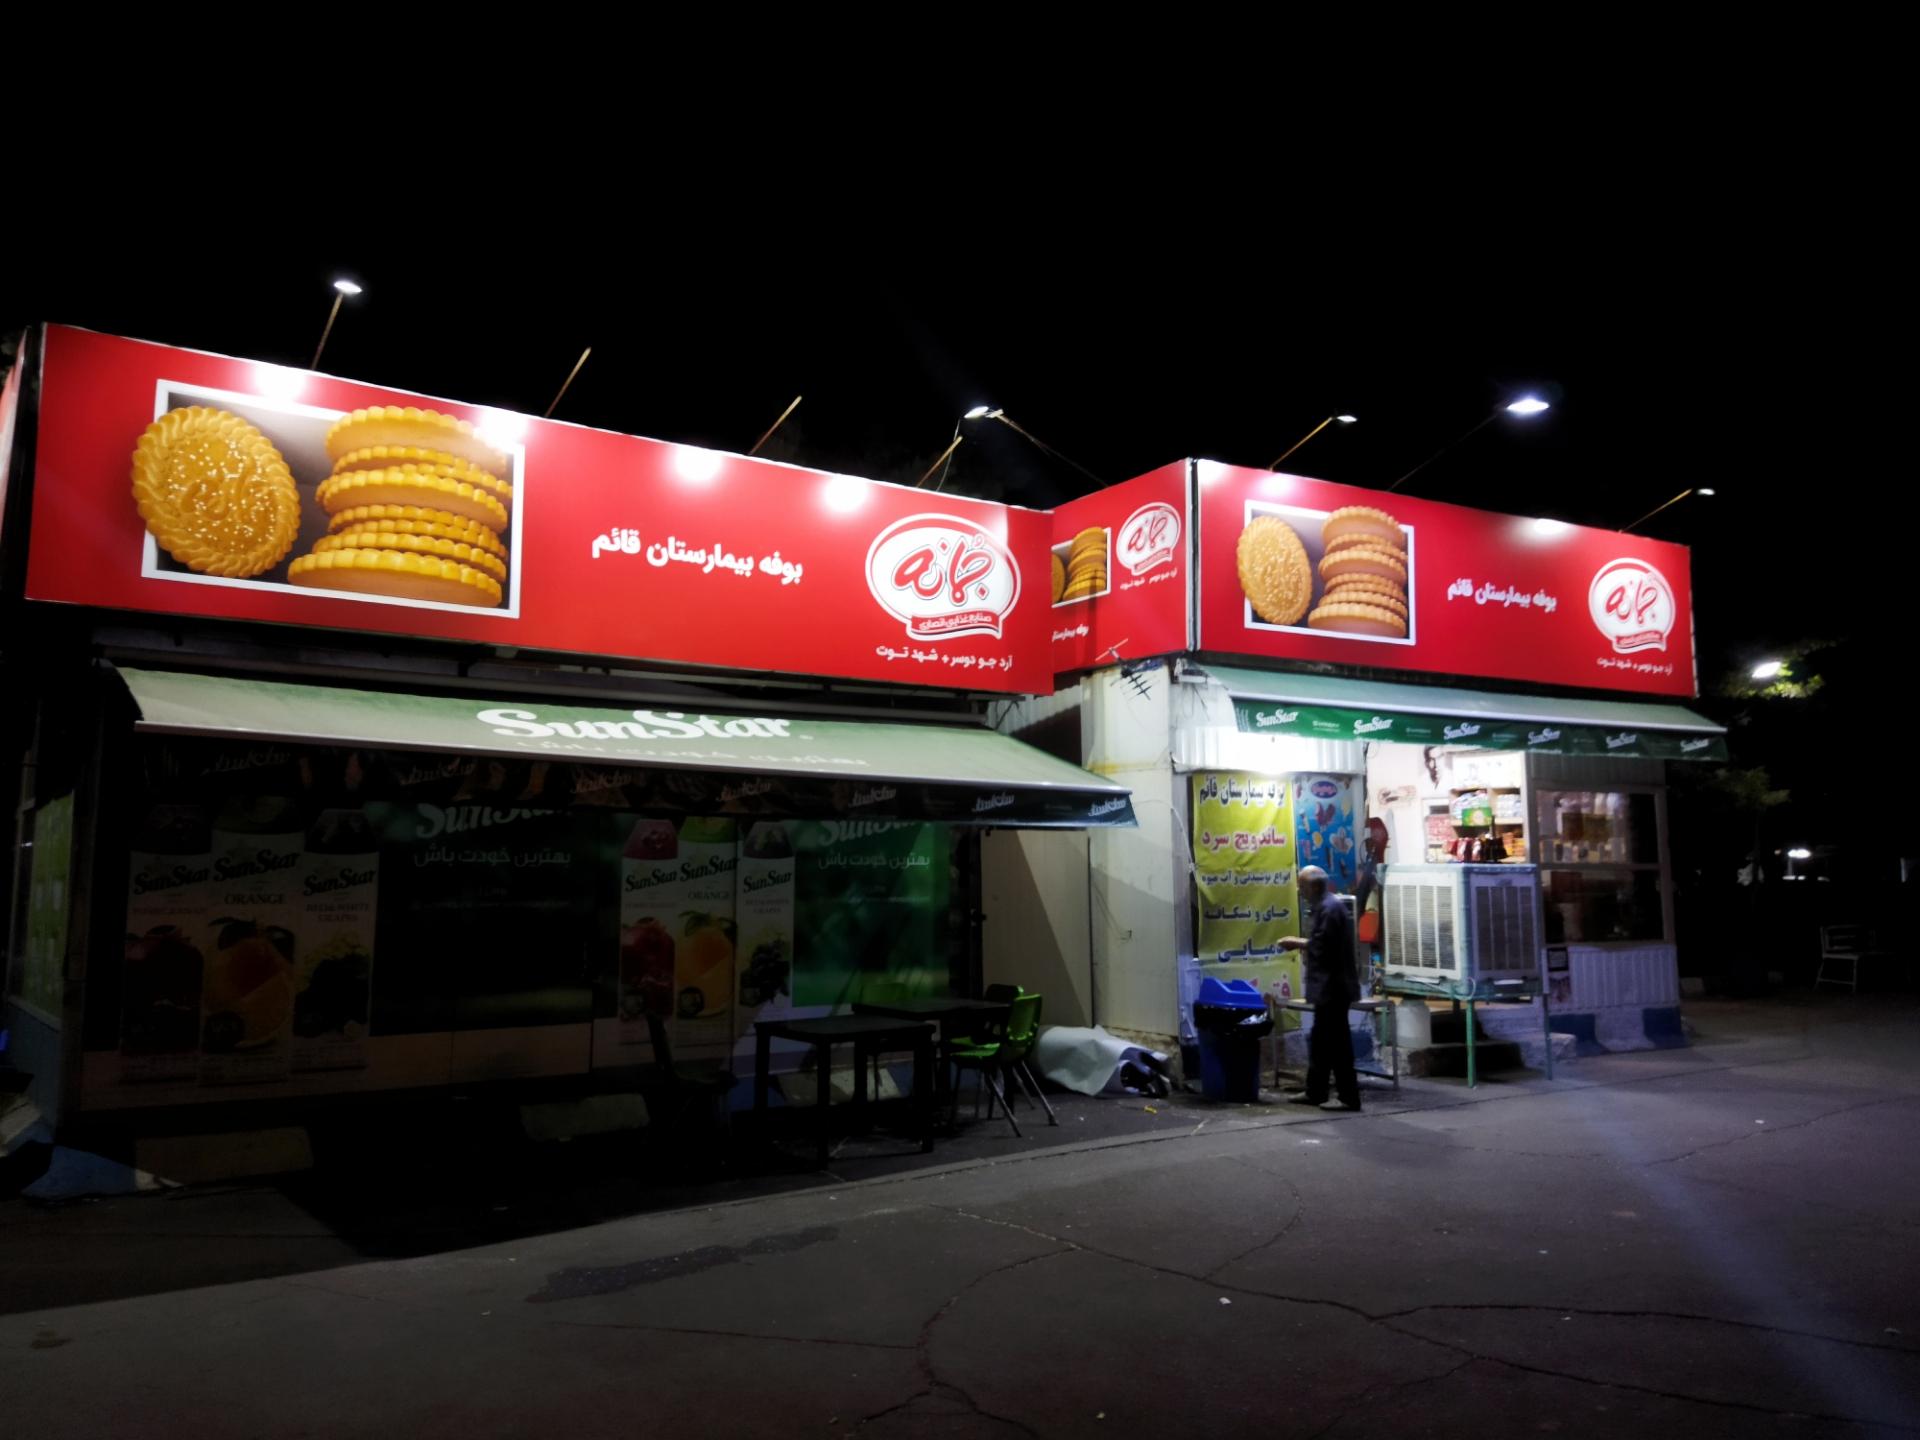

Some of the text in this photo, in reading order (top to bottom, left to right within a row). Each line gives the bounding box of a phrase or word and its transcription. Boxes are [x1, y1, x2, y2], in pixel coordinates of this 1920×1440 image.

[591, 528, 804, 585] بوفه بیمارستان قائم
[1447, 578, 1557, 613] بوفه بیمارستان قائم
[876, 644, 910, 662] توت
[911, 647, 939, 664] شهد
[950, 655, 977, 668] دوسر
[978, 657, 997, 669] جو
[999, 656, 1012, 672] آرد
[477, 708, 791, 740] SunStar
[1255, 708, 1298, 728] SunStar
[1353, 716, 1394, 735] SunStar
[1443, 722, 1481, 741] SunStar
[1527, 728, 1561, 746] SunStar
[1606, 732, 1637, 749] SunStar
[1200, 775, 1218, 805] قائم
[1202, 828, 1286, 851] ساندویچ سرد
[414, 842, 456, 868] باش
[457, 846, 511, 867] خودت
[213, 850, 300, 882] SunStar
[680, 855, 739, 882] SunStar
[134, 865, 211, 895] SunStar
[303, 868, 376, 897] SunStar
[625, 868, 678, 892] SunStar
[743, 870, 792, 893] SunStar
[224, 893, 285, 905] ORANGE
[1263, 905, 1290, 922] چای
